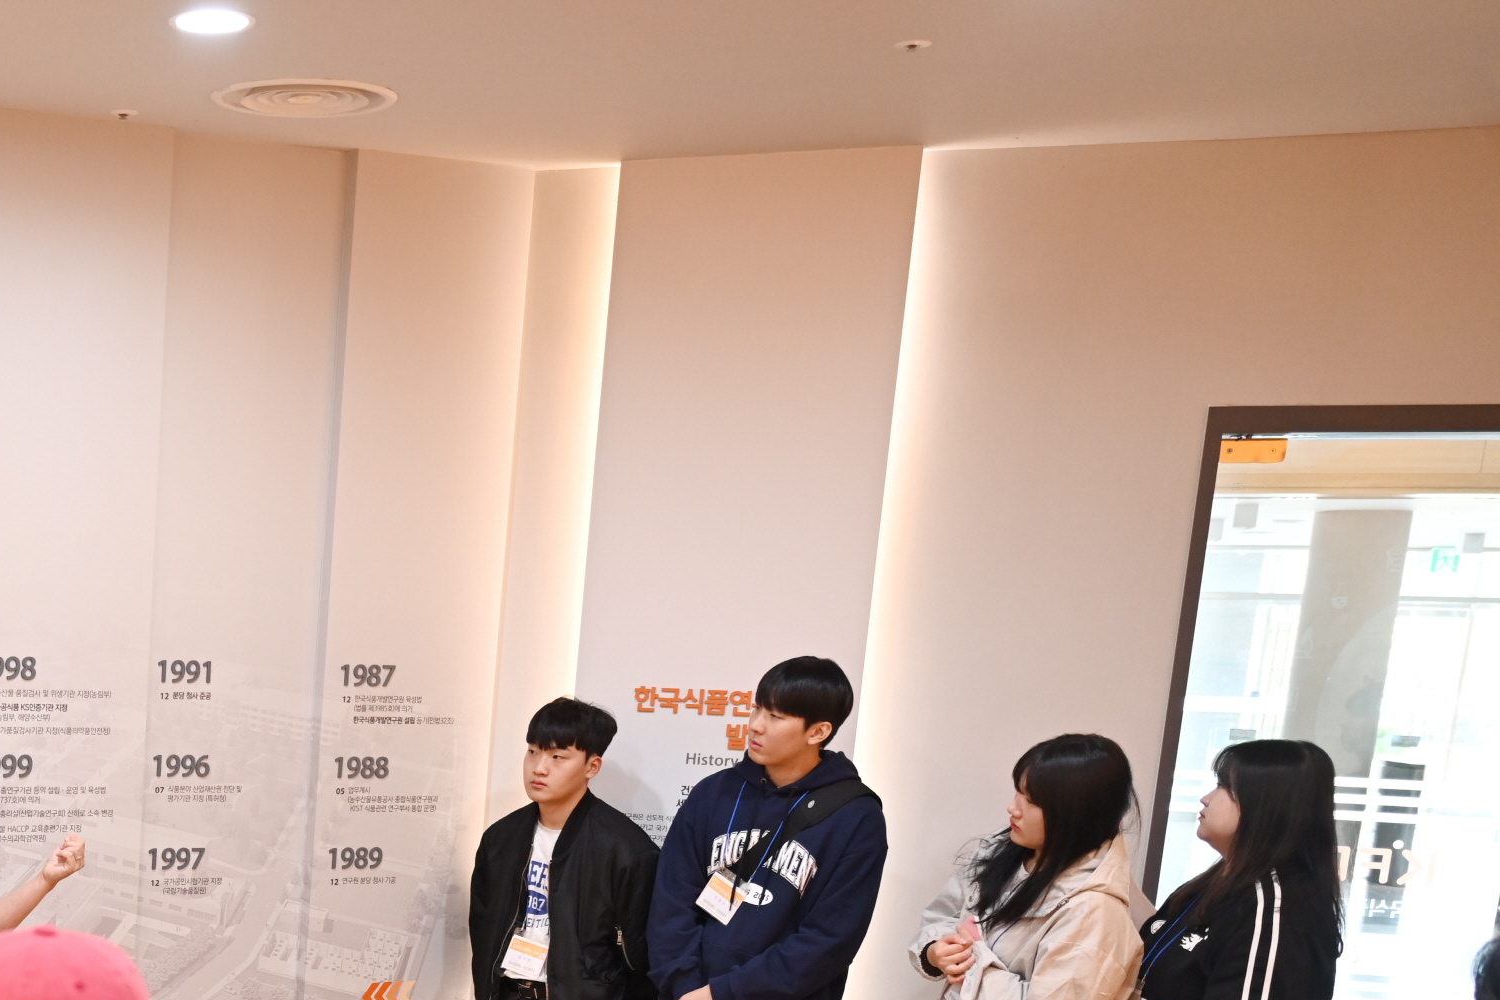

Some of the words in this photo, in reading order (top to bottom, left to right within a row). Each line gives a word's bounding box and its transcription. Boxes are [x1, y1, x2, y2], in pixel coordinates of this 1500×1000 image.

[157, 659, 212, 684] 1991
[340, 663, 396, 687] 1987
[160, 692, 170, 700] 12
[199, 692, 212, 700] 준공
[634, 685, 756, 717] 한국식품연
[55, 703, 68, 712] 지정
[153, 754, 211, 778] 1996
[334, 756, 390, 779] 1988
[685, 752, 739, 768] History
[154, 786, 165, 794] 07
[335, 787, 345, 795] 05
[148, 847, 206, 871] 1997
[328, 846, 384, 870] 1989
[151, 879, 160, 887] 12
[330, 878, 339, 886] 12
